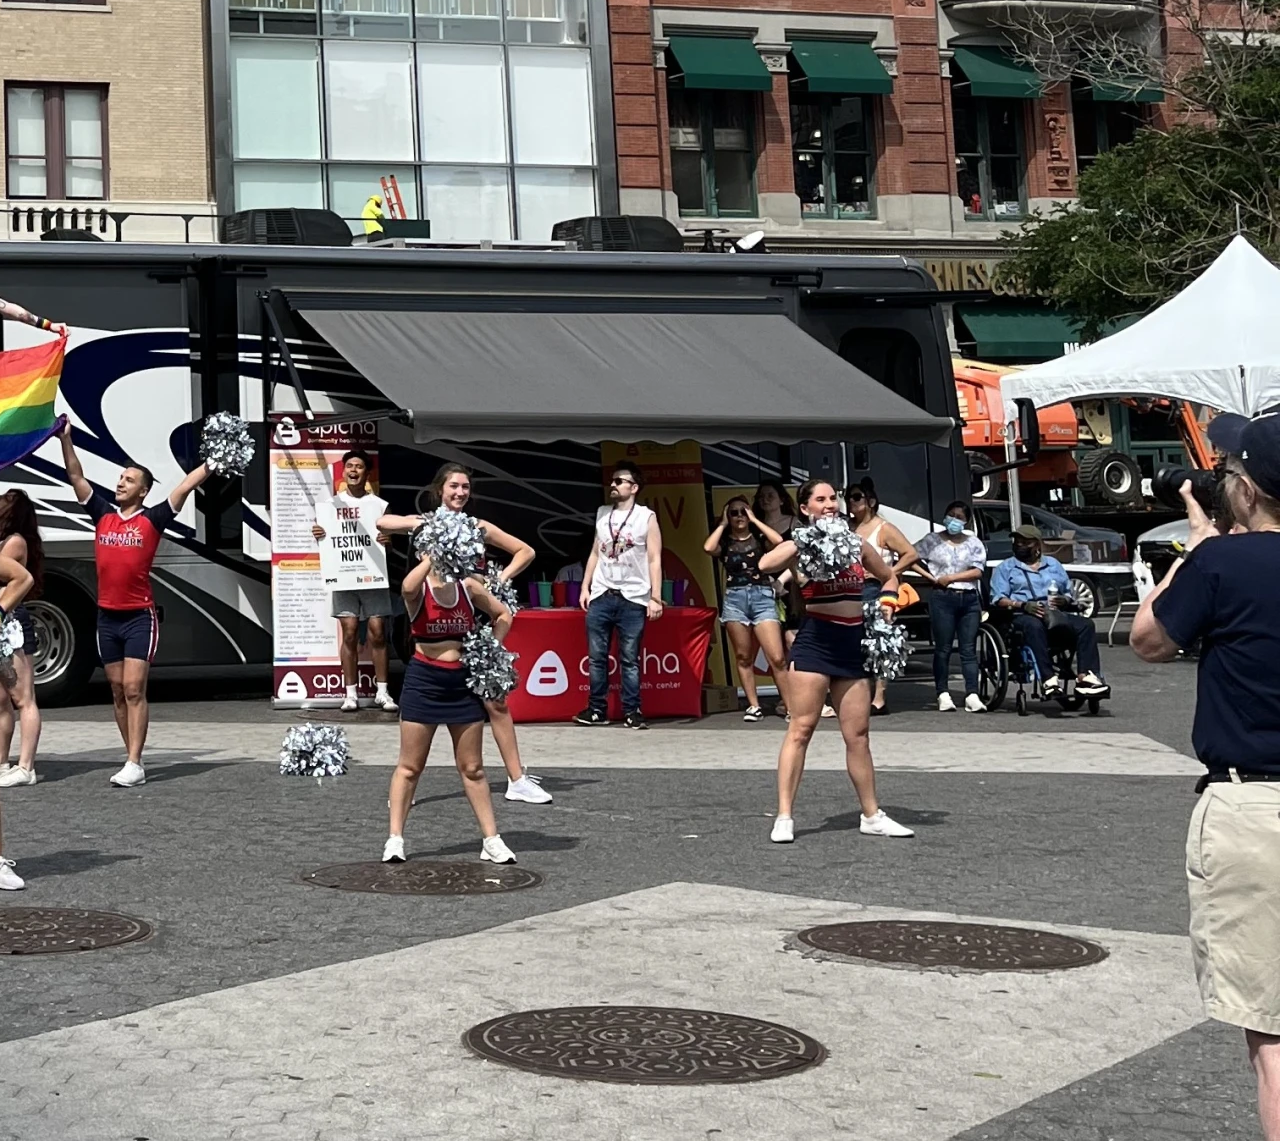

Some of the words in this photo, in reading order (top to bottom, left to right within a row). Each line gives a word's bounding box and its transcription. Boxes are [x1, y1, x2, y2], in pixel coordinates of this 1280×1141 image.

[336, 507, 361, 520] FREE
[341, 521, 358, 534] HIV
[331, 535, 372, 548] TESTING
[341, 549, 364, 562] NOW
[426, 623, 448, 634] NEW
[655, 681, 681, 689] center
